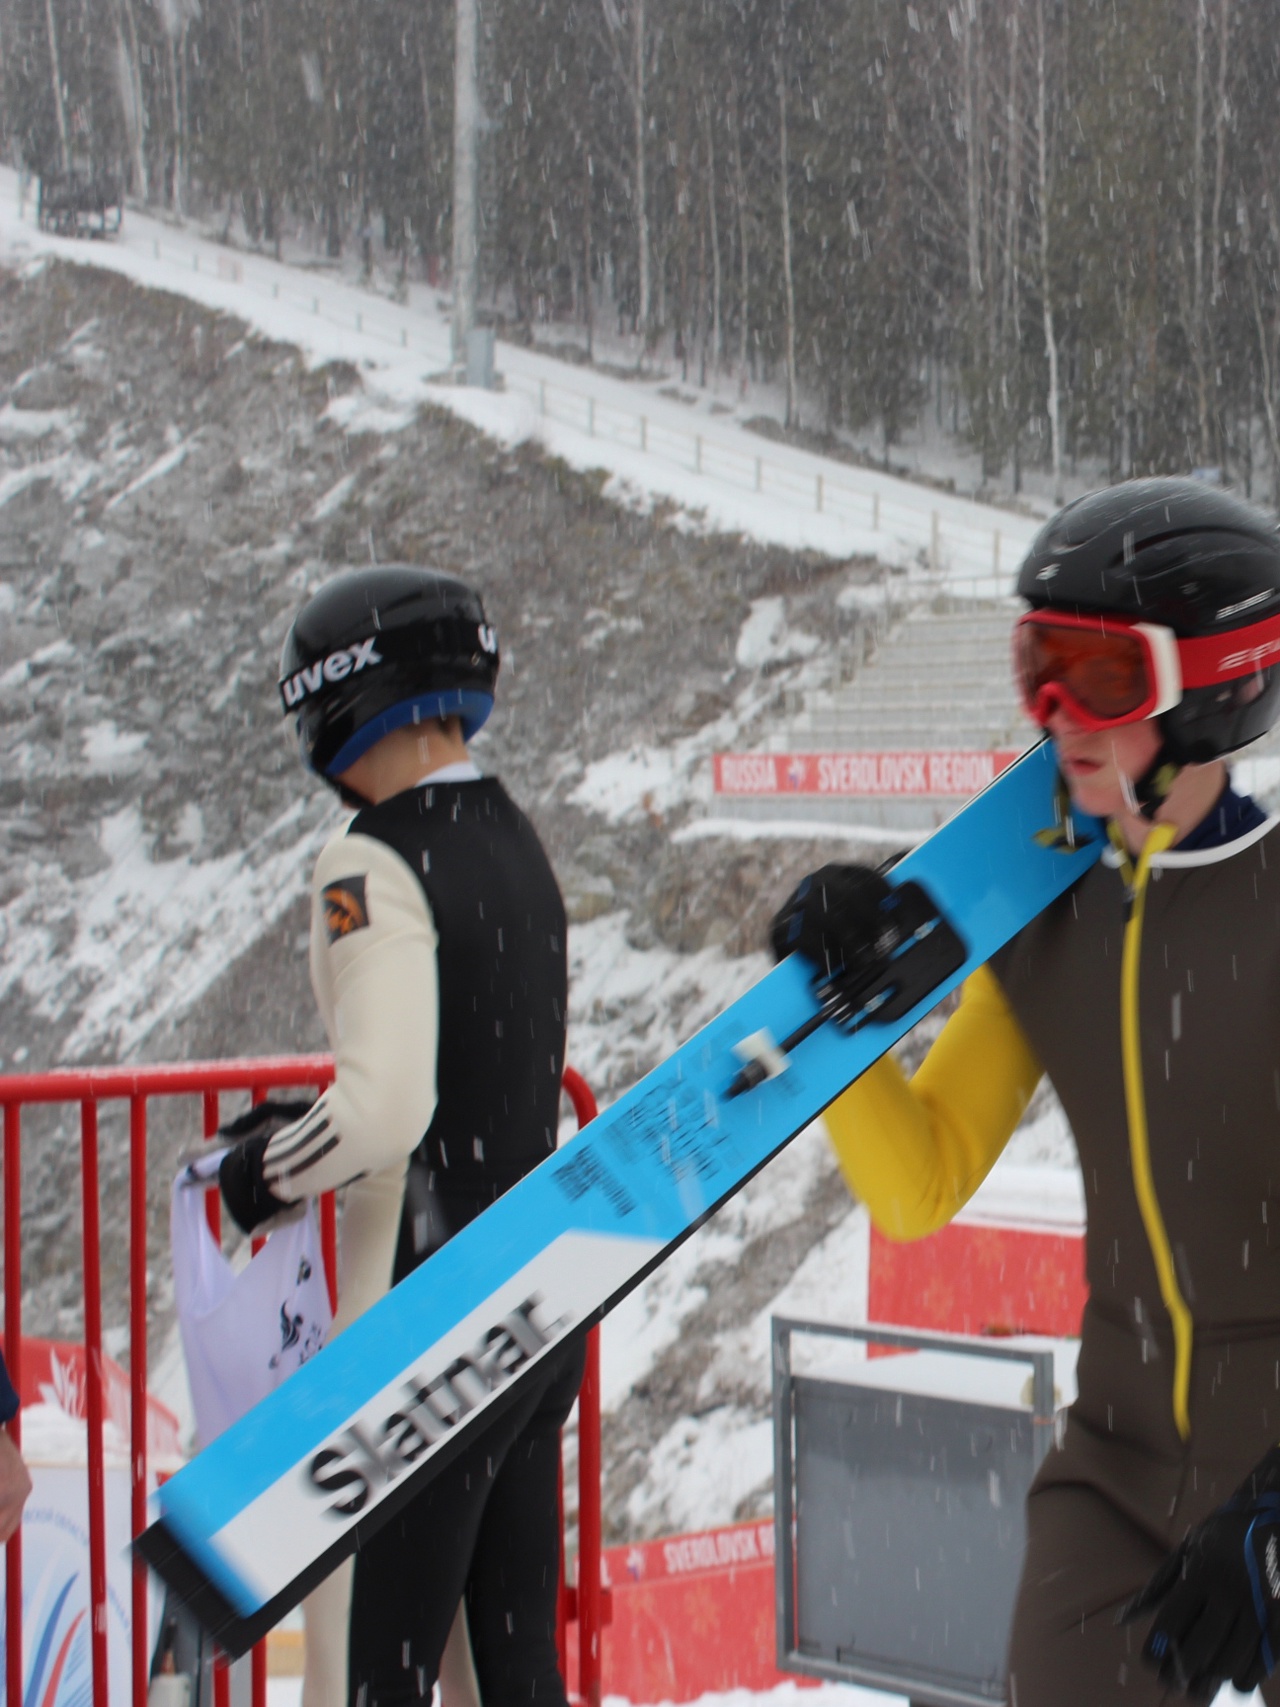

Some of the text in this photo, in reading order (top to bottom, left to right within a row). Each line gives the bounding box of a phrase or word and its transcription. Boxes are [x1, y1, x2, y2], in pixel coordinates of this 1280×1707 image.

[282, 636, 383, 707] uvex
[721, 755, 994, 790] RUSSIA SVERDLOVSK REGION
[306, 1289, 553, 1516] Slatnar
